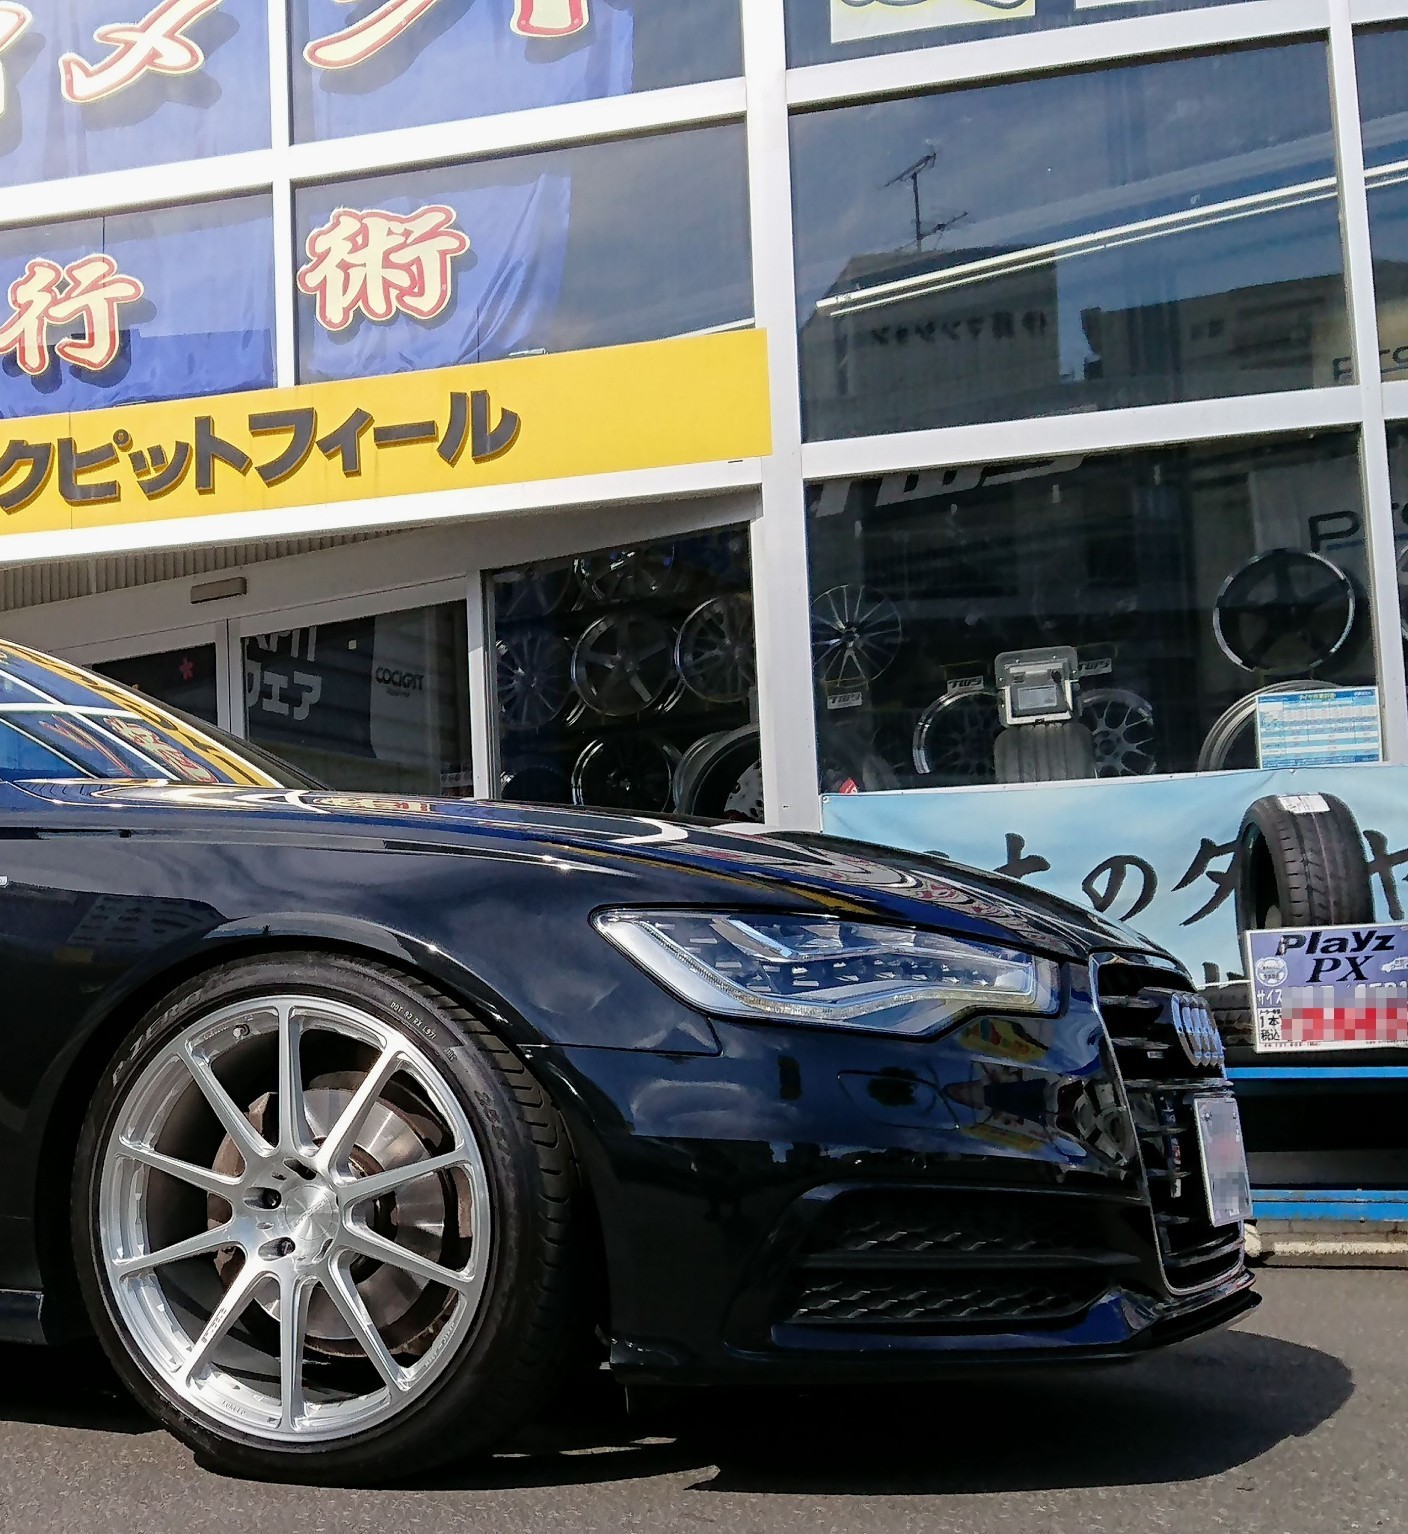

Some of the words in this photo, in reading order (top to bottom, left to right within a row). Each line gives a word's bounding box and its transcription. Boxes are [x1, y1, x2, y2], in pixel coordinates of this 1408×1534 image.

[1275, 930, 1395, 957] Playz
[1305, 955, 1374, 983] PX
[127, 988, 204, 1061] ZERO
